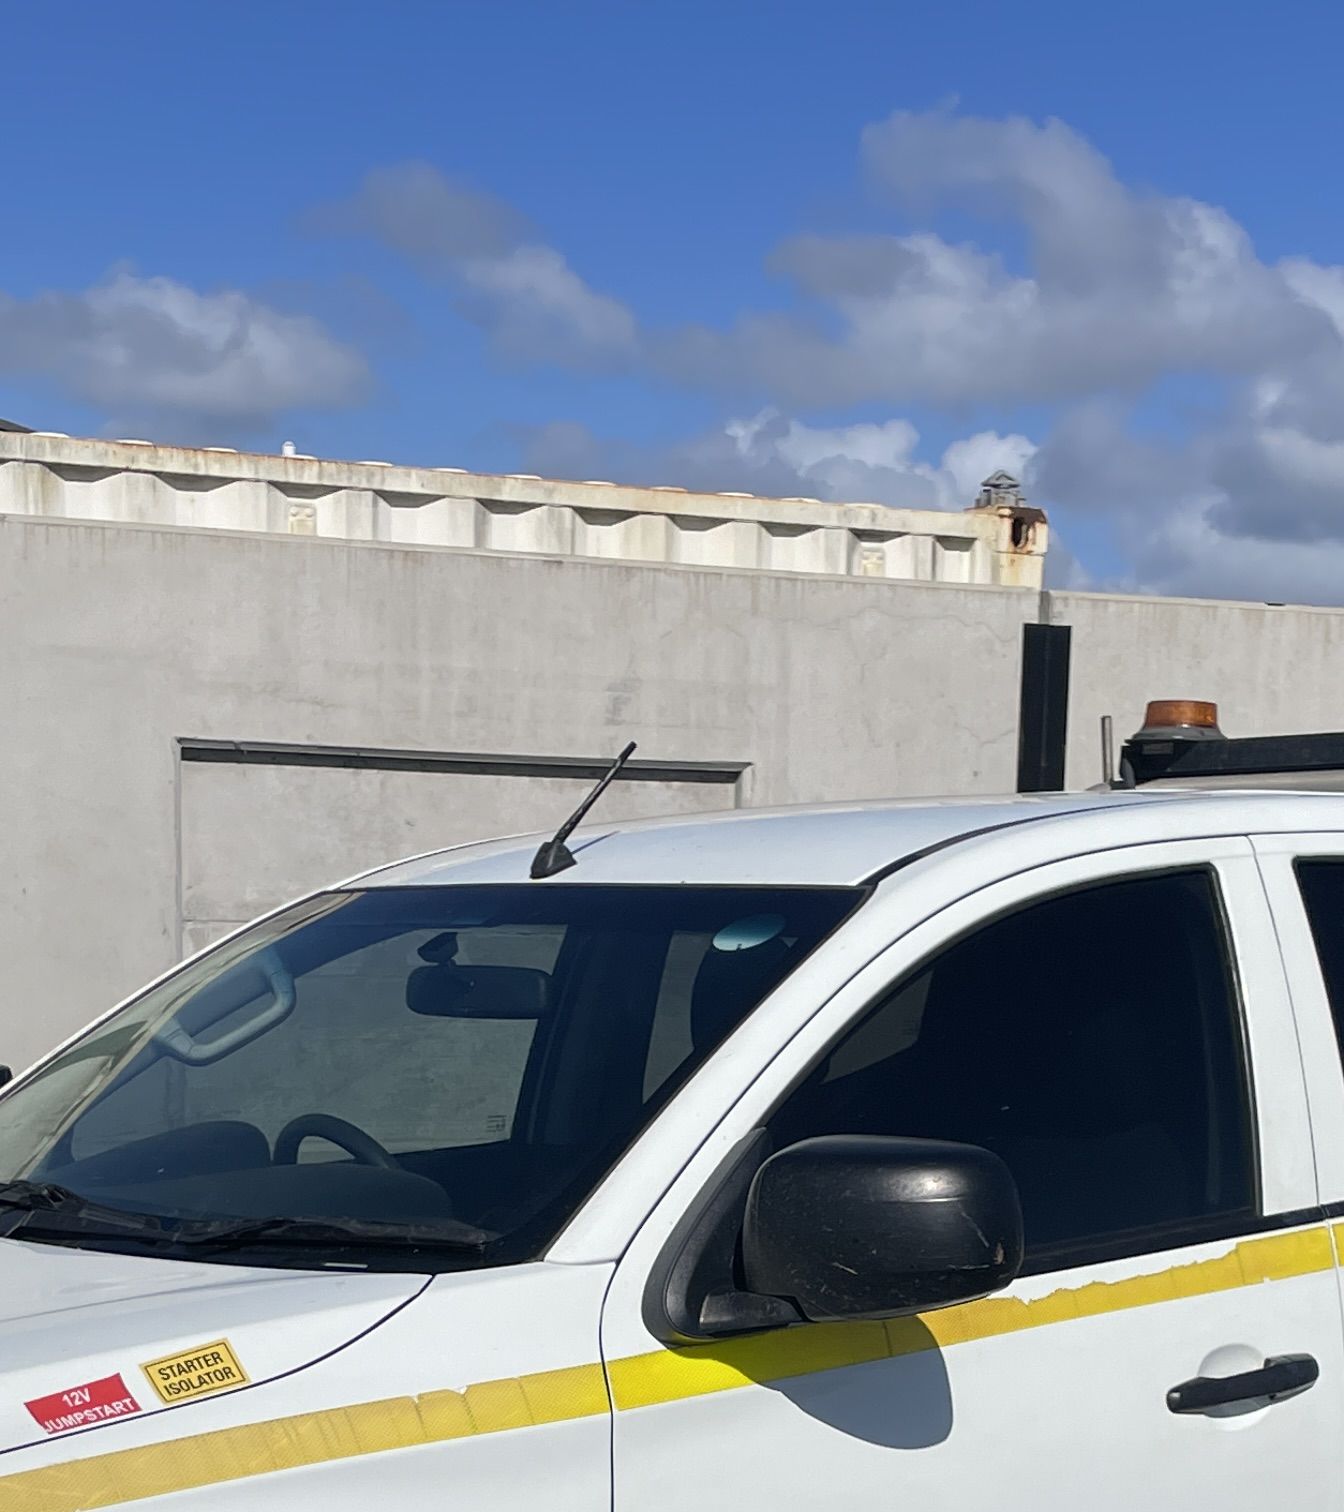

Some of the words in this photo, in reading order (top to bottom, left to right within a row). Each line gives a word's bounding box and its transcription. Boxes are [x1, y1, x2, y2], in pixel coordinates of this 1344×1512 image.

[158, 1350, 224, 1382] STARTER
[163, 1366, 236, 1397] ISOLATOR
[61, 1387, 91, 1408] 12V
[44, 1398, 135, 1433] JUMPSTART
